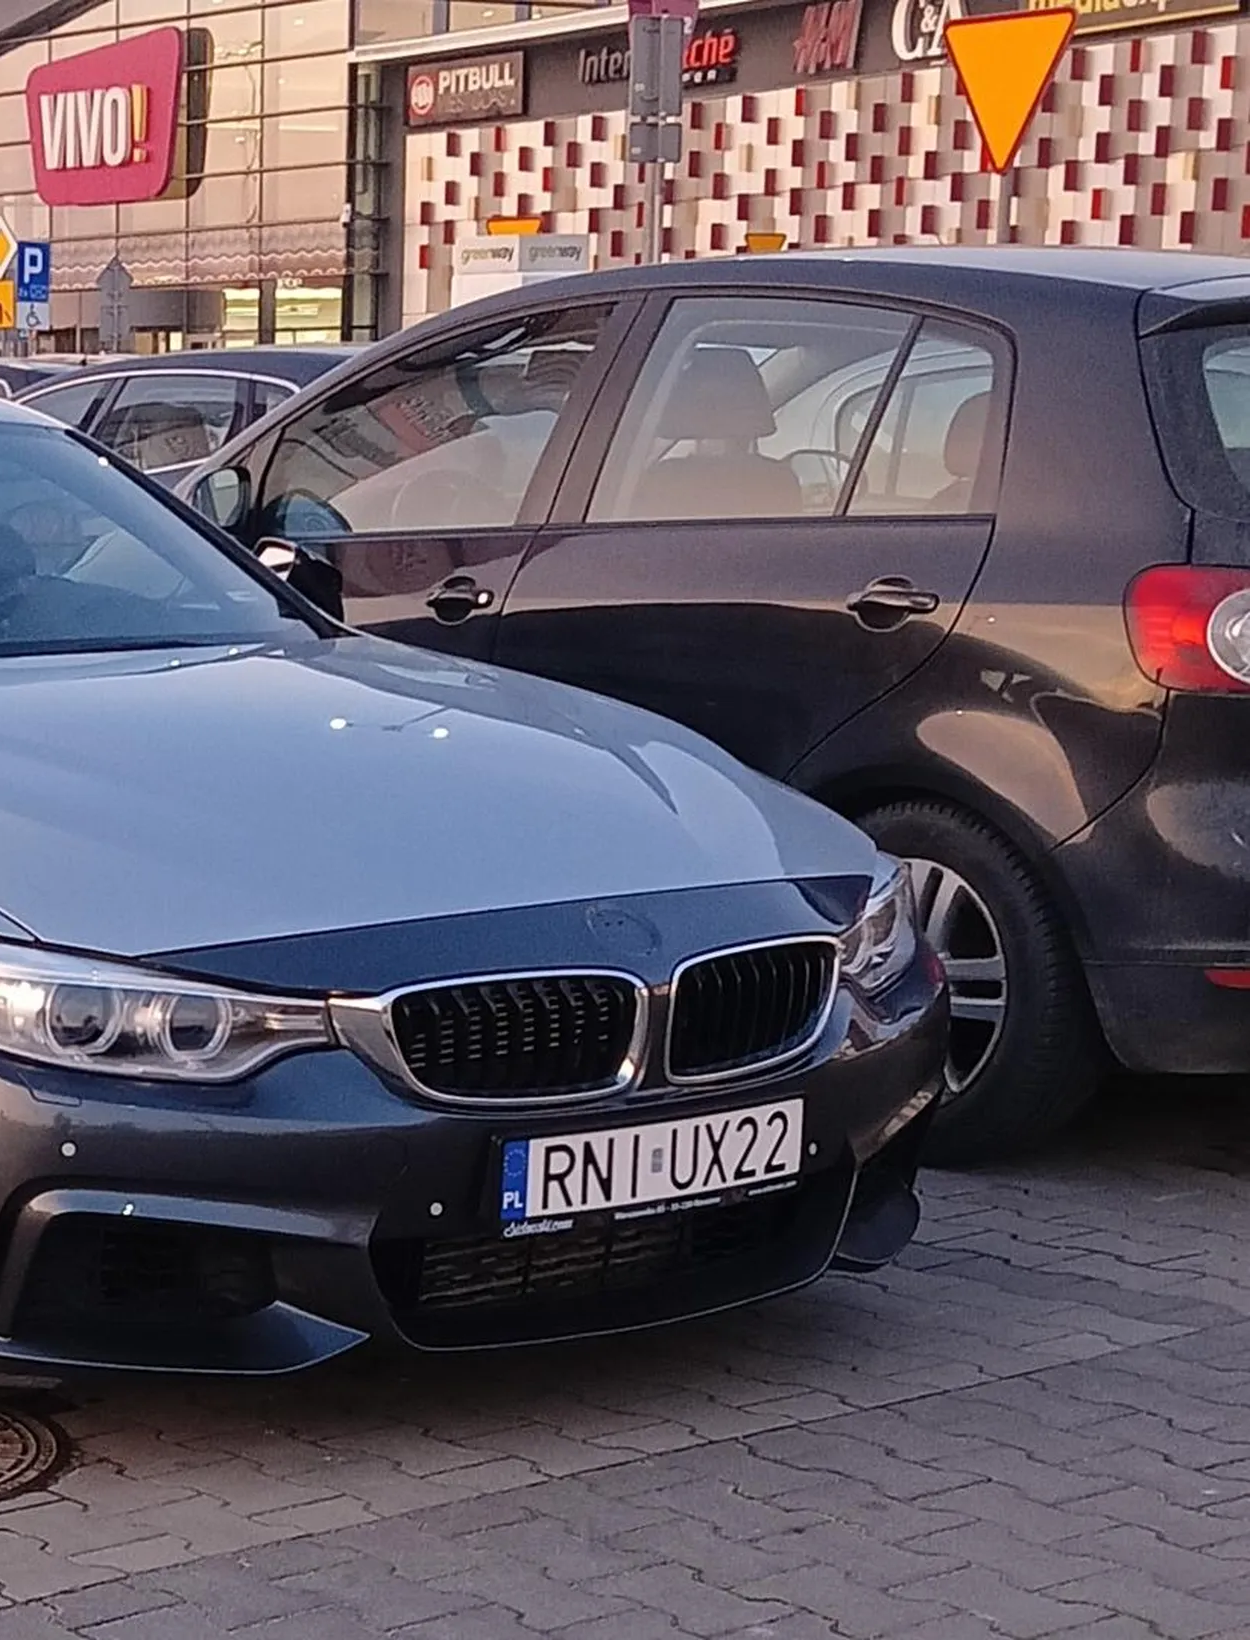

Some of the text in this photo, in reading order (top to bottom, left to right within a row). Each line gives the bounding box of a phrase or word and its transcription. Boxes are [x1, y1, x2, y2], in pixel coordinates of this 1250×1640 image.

[892, 0, 963, 60] C&A
[439, 62, 515, 95] PITBULL
[40, 83, 148, 170] VIVO!
[23, 248, 43, 284] P
[542, 1110, 789, 1210] RNI UX22
[502, 1190, 524, 1210] PL
